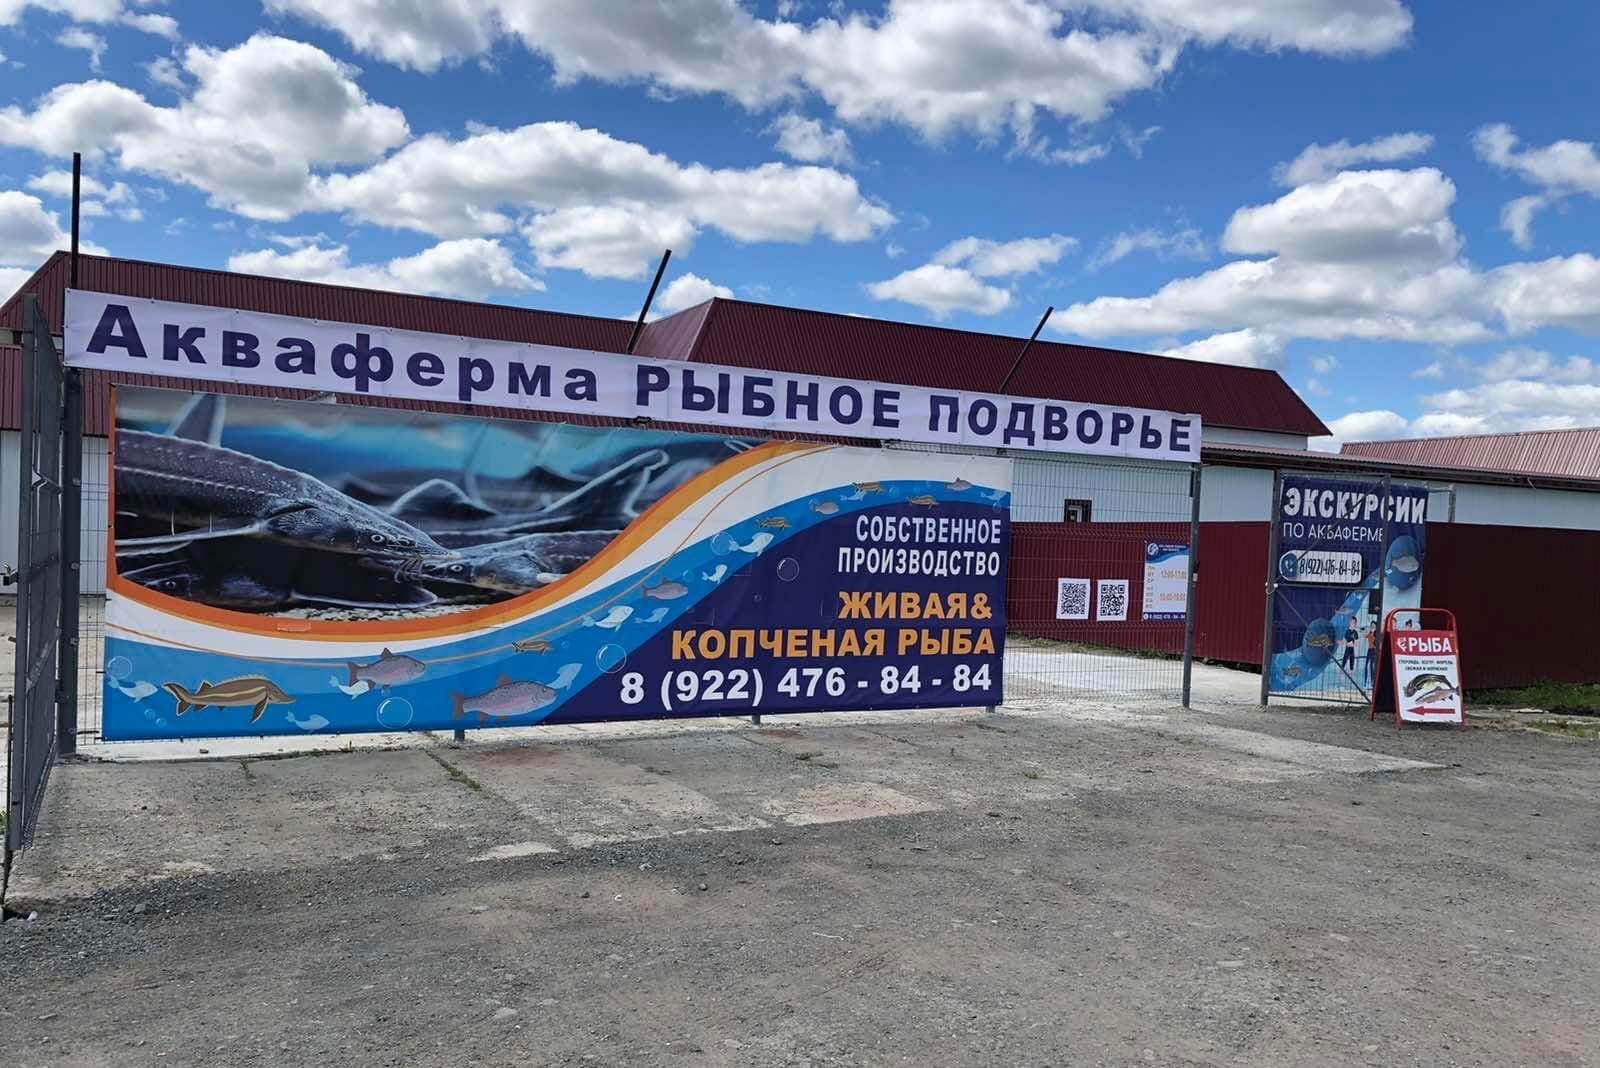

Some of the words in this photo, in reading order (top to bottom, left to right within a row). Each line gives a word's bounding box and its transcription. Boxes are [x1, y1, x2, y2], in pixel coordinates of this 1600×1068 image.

[86, 304, 599, 402] Акваферма
[636, 365, 900, 428] РЫБНОЕ
[929, 395, 1191, 452] ПОДВОРЬЕ
[1283, 487, 1426, 524] ЭКСКУРСИИ
[856, 514, 1001, 544] СОБСТВЕННОЕ
[1283, 523, 1304, 538] ПО
[838, 547, 1001, 577] ПРОИЗВОДСТВО
[838, 591, 993, 619] ЖИВАЯ&
[671, 629, 885, 660] КОПЧЕНАЯ
[900, 628, 996, 655] РЫБА
[1408, 637, 1452, 653] РЫБА
[620, 672, 645, 704] 8
[660, 668, 764, 710] (922)
[777, 667, 846, 698] 476
[880, 664, 921, 693] 84
[953, 663, 992, 691] 84
